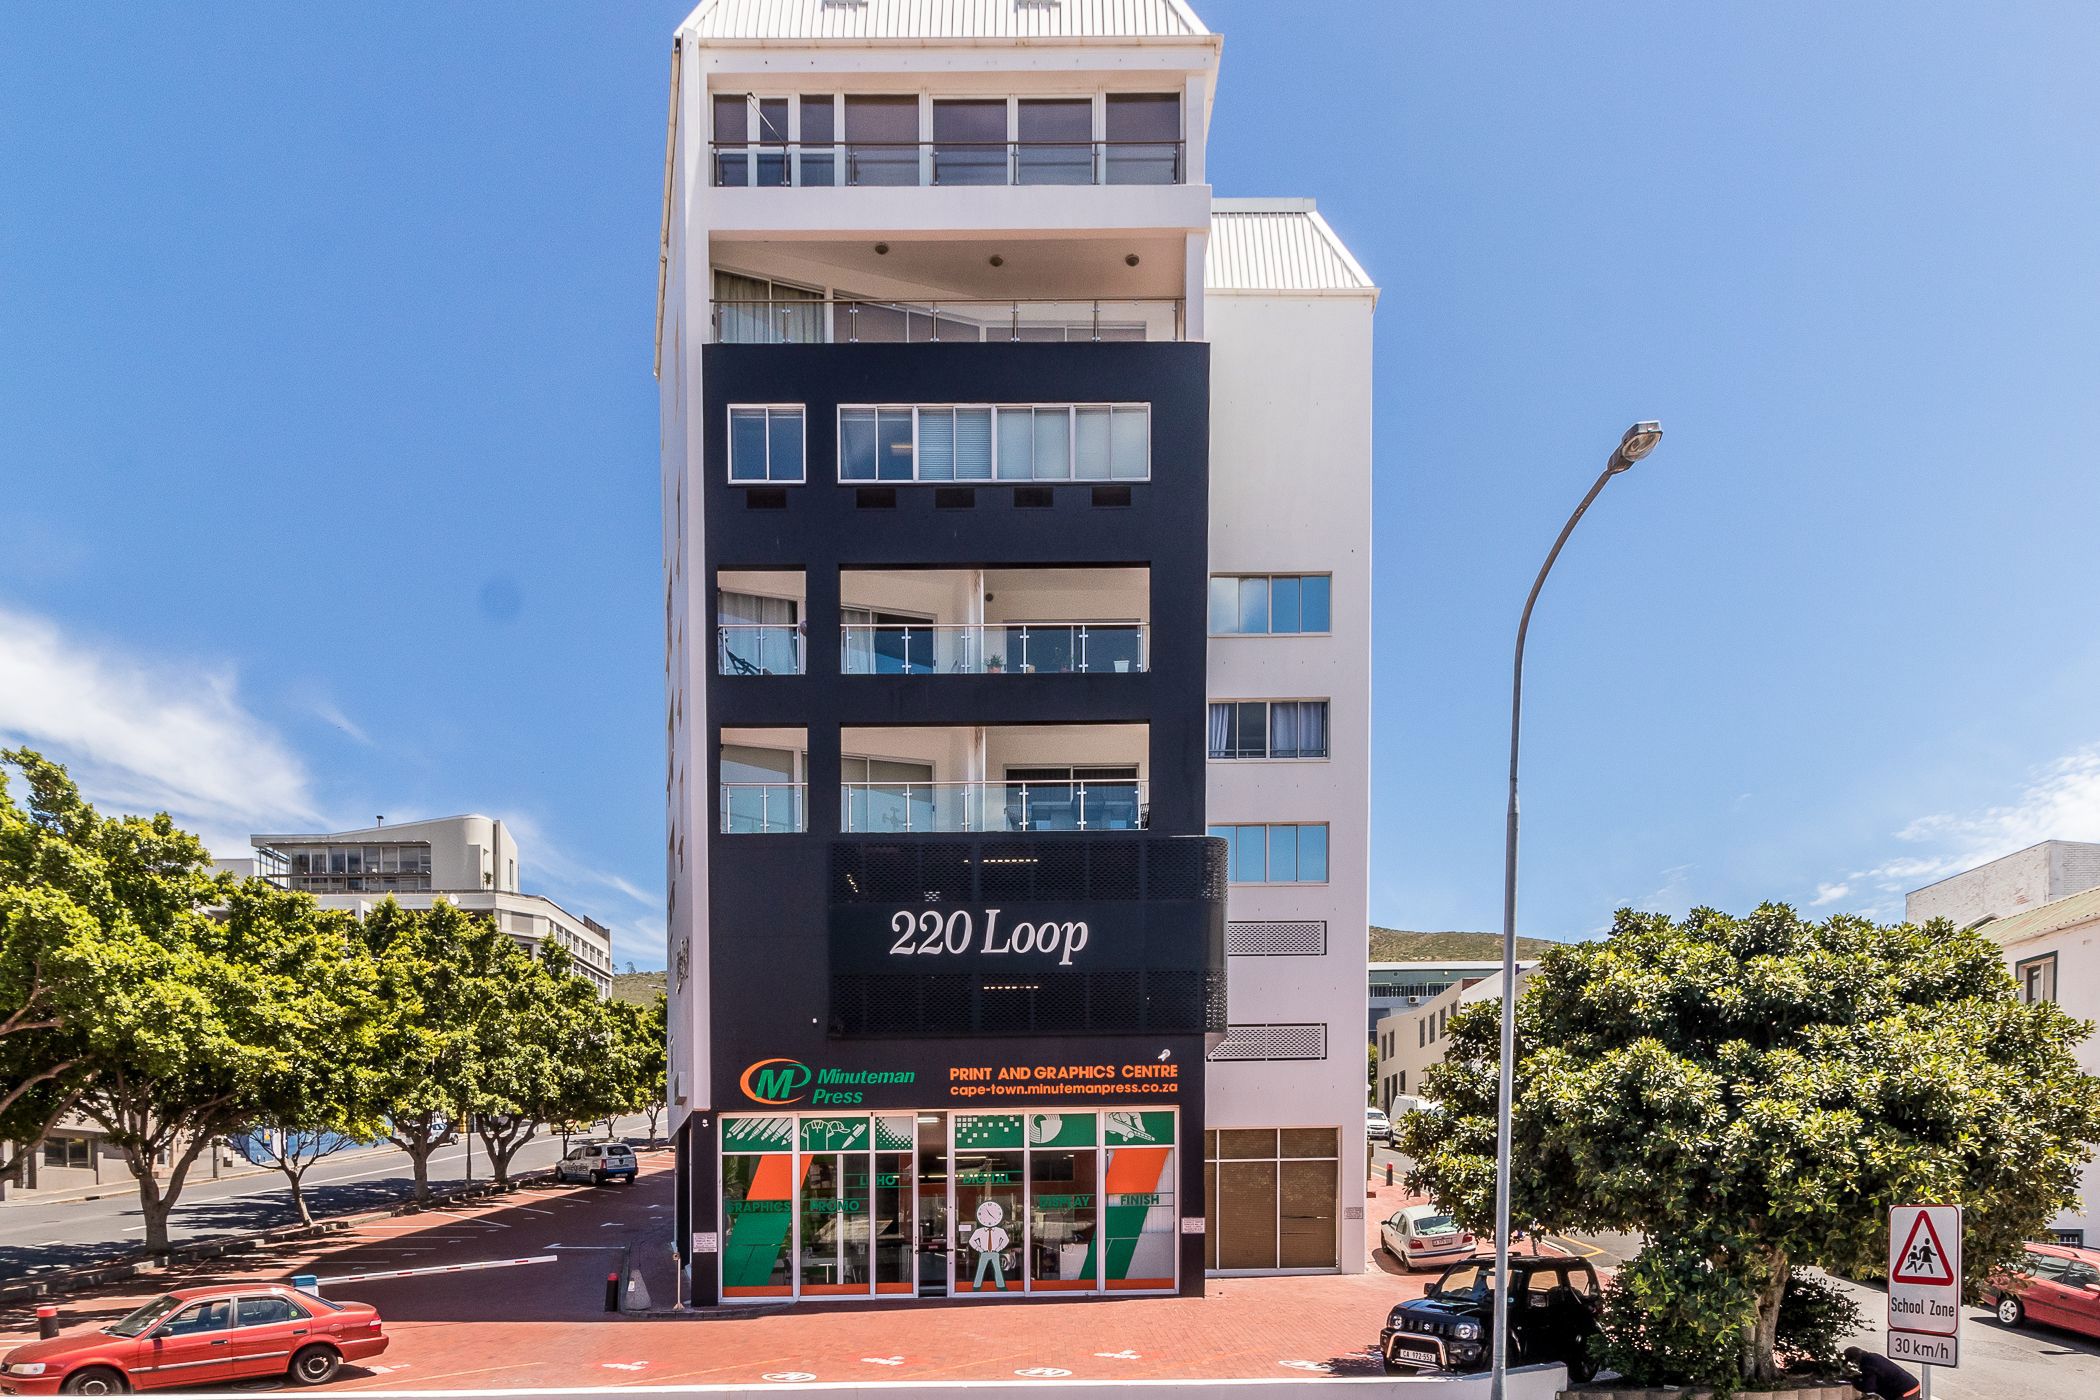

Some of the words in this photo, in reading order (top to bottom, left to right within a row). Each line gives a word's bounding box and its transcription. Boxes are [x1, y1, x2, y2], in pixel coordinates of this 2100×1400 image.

[889, 909, 972, 955] 220
[981, 909, 1088, 965] Loop
[817, 1068, 916, 1085] Minuteman
[949, 1067, 992, 1081] PRINT
[998, 1067, 1031, 1080] AND
[1034, 1065, 1115, 1080] GRAPHICS
[1121, 1064, 1178, 1078] CENTRE
[812, 1088, 863, 1105] Press
[950, 1082, 1178, 1097] cape-town.minutemanpress.co.za
[860, 1175, 896, 1186] LIHO
[809, 1200, 860, 1212] PROMO
[1120, 1195, 1160, 1206] FINISH
[1891, 1297, 1924, 1315] School
[1930, 1300, 1954, 1317] Zone
[1895, 1338, 1910, 1354] 30
[1913, 1339, 1949, 1360] km/h
